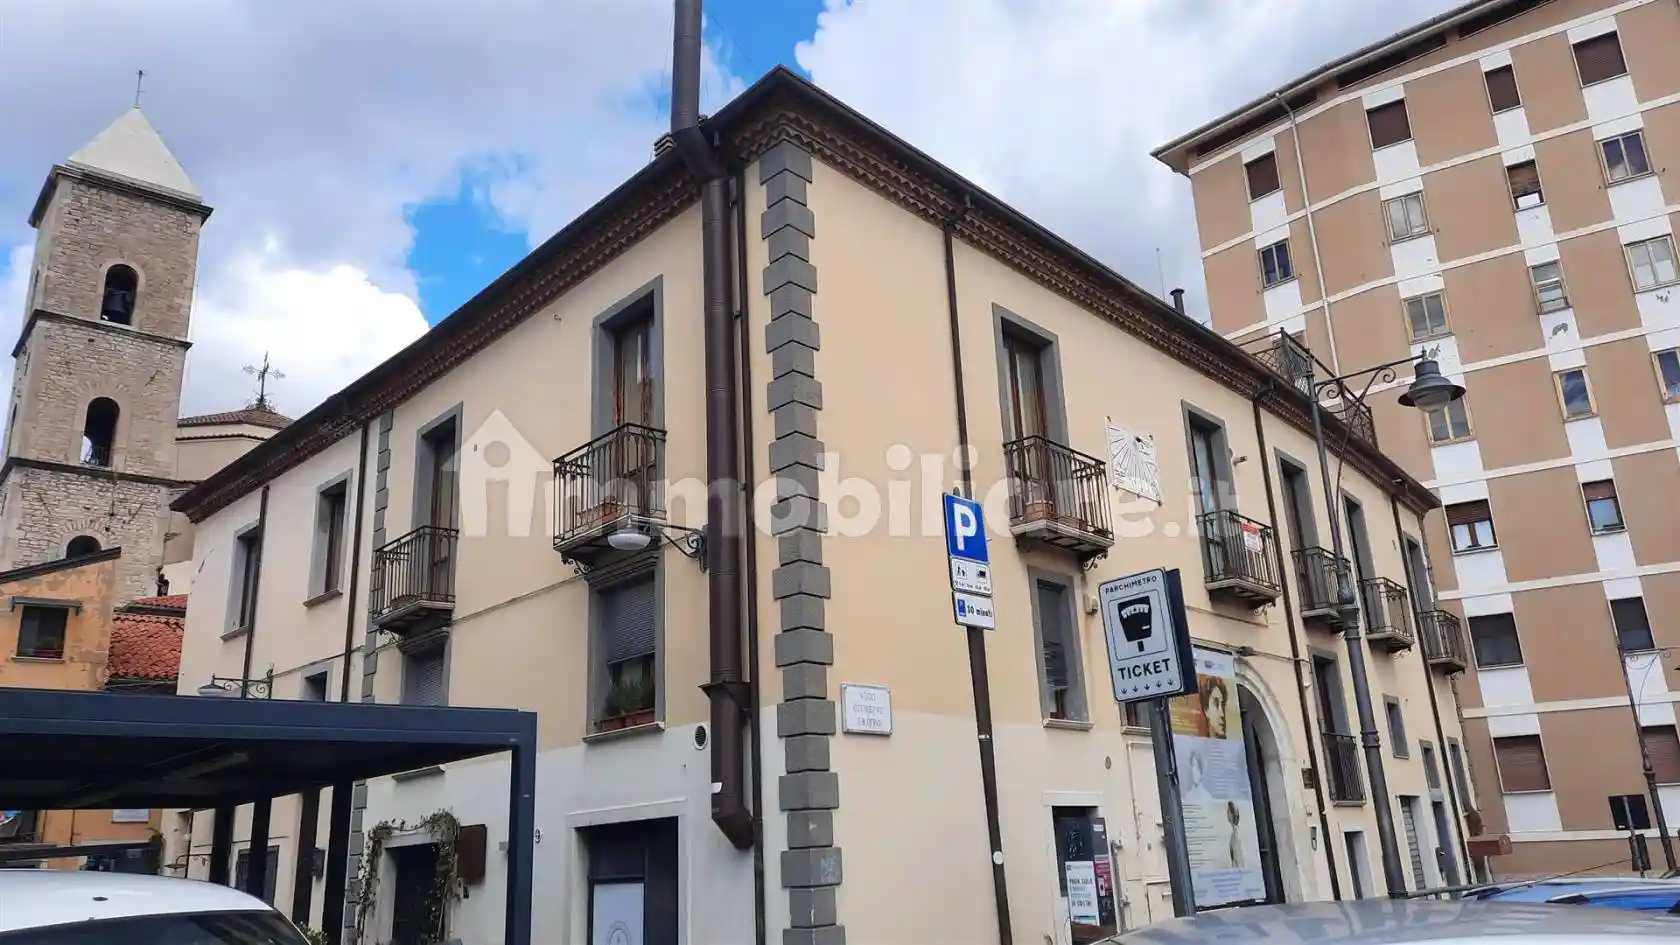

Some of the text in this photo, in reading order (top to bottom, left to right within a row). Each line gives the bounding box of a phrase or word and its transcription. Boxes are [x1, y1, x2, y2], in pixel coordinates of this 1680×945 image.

[953, 502, 977, 550] P
[1105, 575, 1157, 594] PARCHIMETRO
[1118, 658, 1171, 680] TICKET
